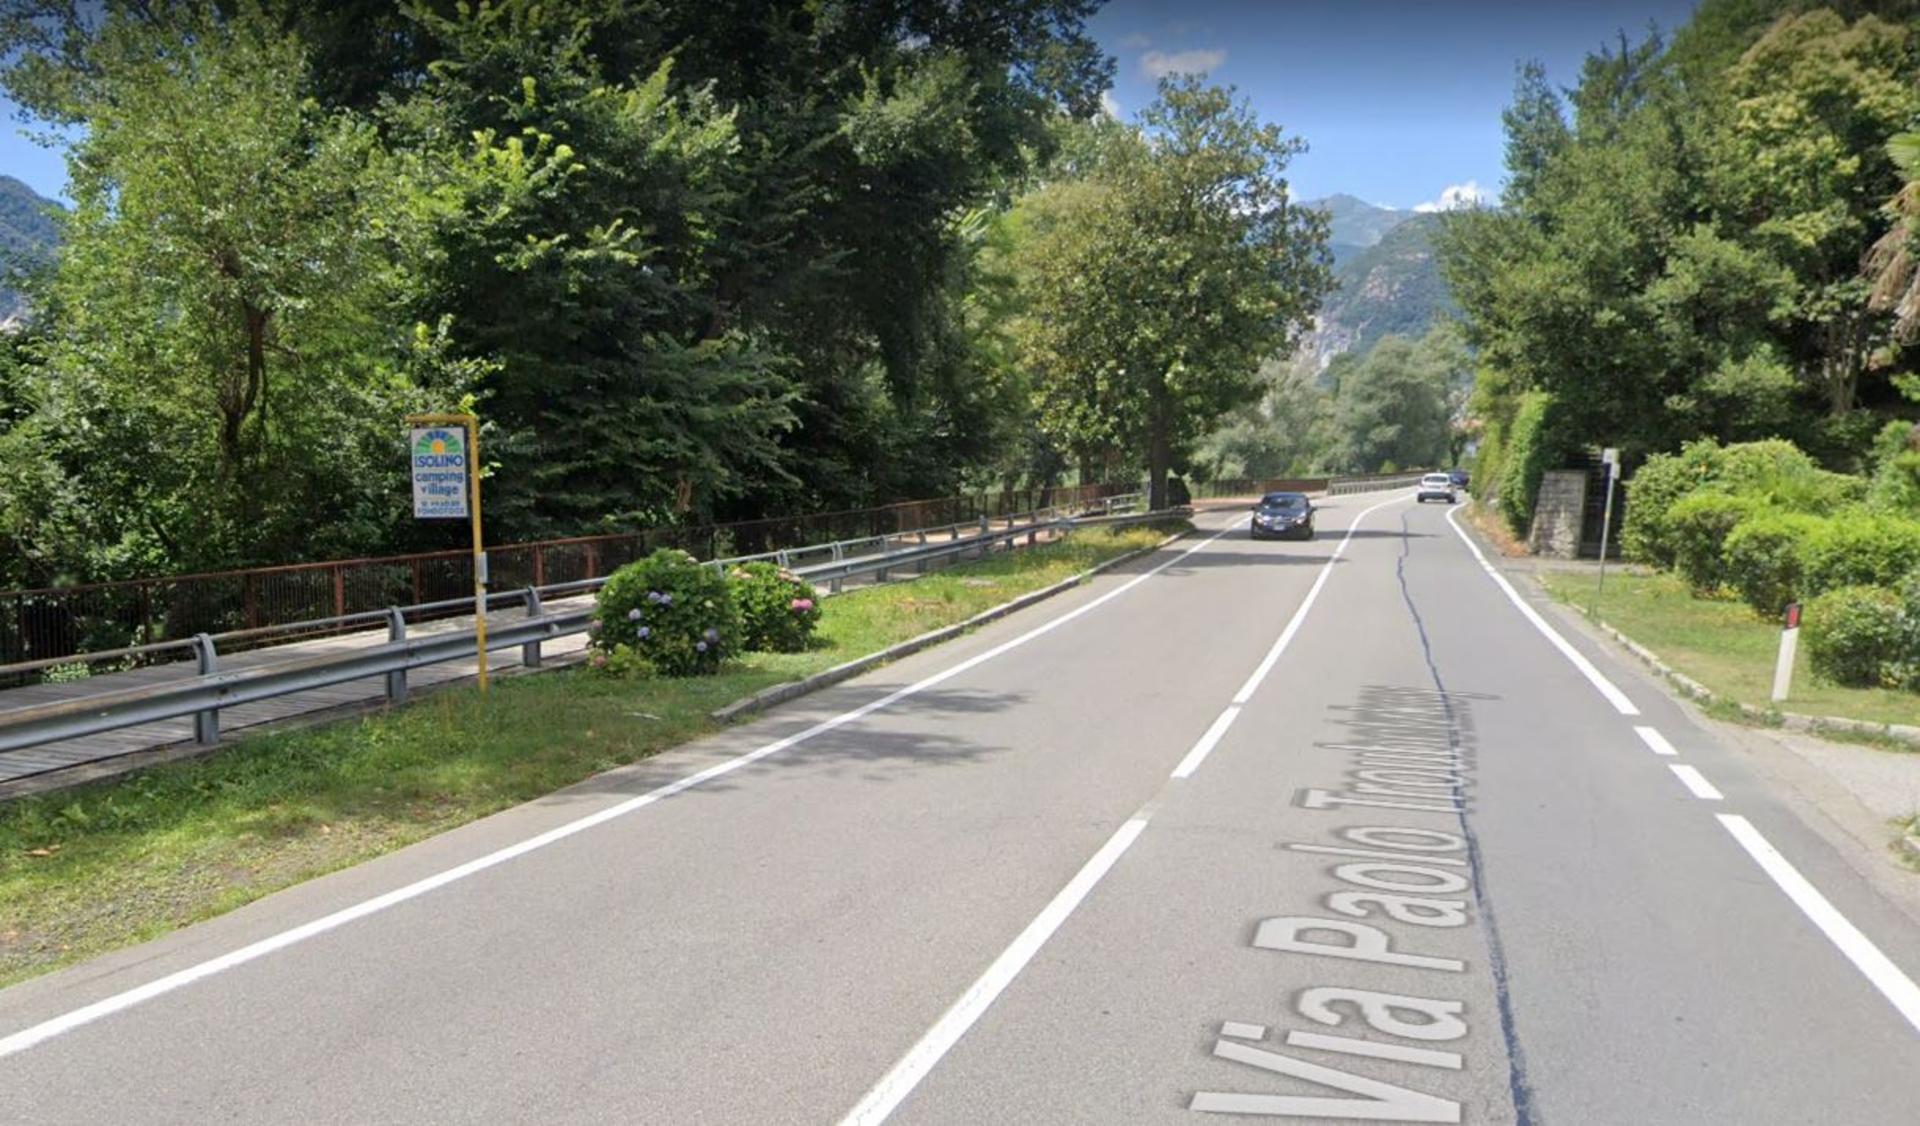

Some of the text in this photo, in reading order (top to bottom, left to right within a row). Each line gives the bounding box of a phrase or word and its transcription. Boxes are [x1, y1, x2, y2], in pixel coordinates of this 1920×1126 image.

[415, 455, 463, 467] ISOLINO
[415, 472, 463, 484] camping
[421, 484, 460, 497] village
